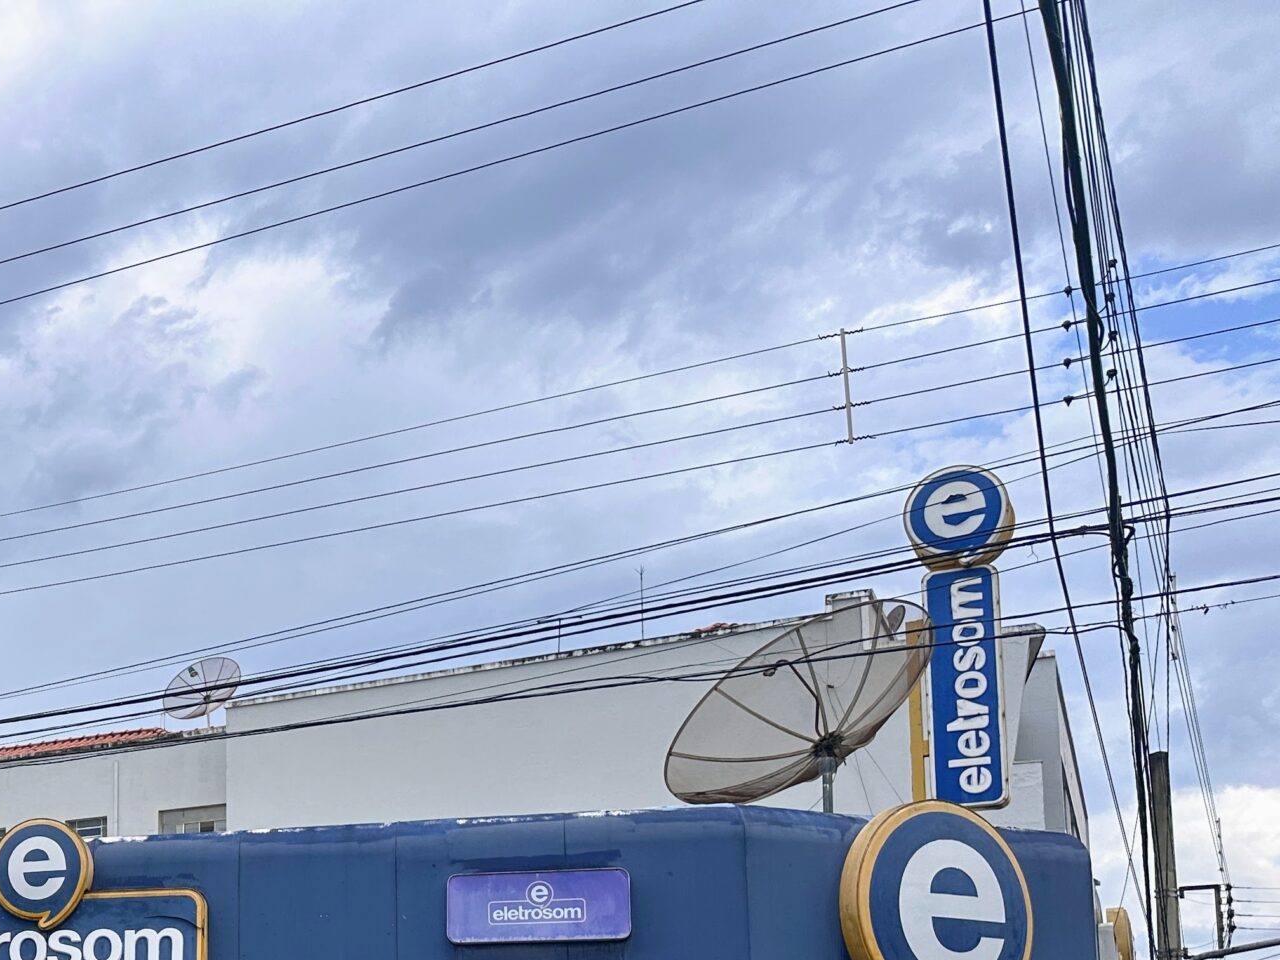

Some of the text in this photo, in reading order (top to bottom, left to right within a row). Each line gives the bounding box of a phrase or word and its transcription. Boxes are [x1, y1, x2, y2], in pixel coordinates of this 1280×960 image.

[923, 481, 987, 538] e
[947, 577, 992, 794] eletrosom
[8, 836, 67, 900] e
[531, 885, 549, 902] e
[493, 905, 582, 921] eletrosom
